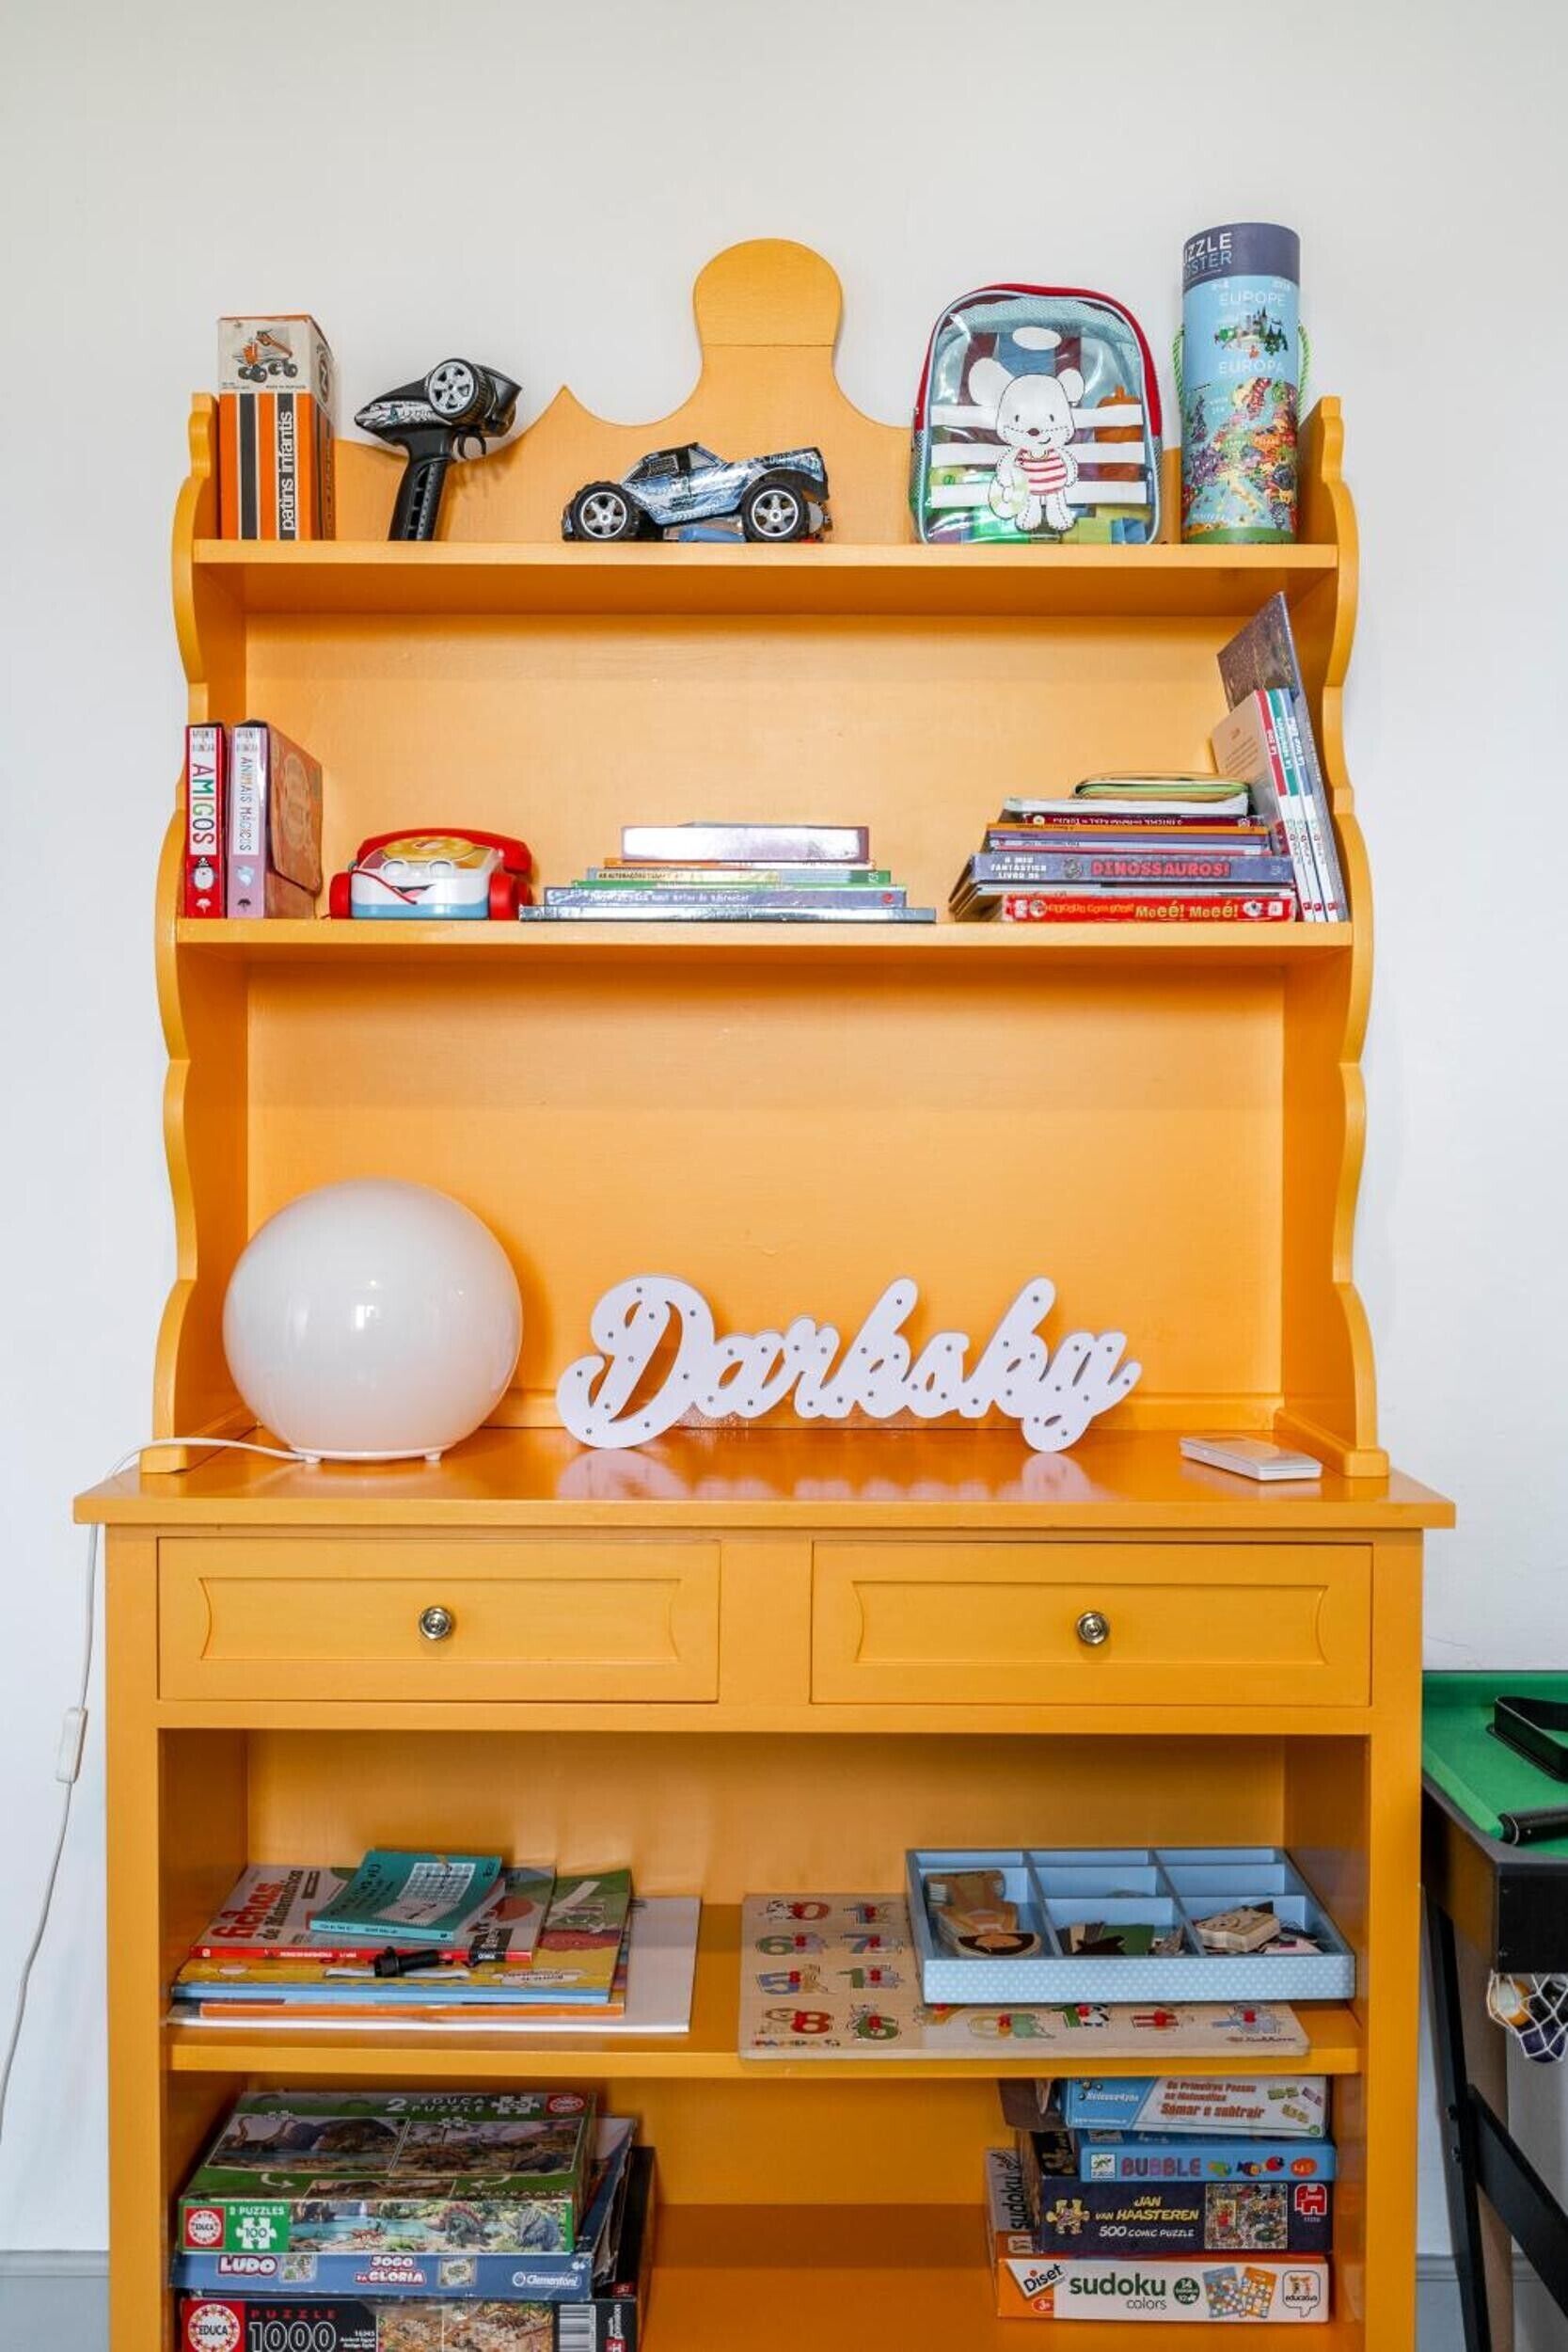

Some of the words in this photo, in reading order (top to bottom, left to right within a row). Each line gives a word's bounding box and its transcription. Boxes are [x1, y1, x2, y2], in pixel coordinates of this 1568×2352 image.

[1219, 291, 1287, 307] EUROPE
[1219, 358, 1287, 374] EUROPA
[278, 411, 294, 473] infantis
[279, 478, 295, 531] patins
[240, 755, 253, 804] ANIMAIS
[192, 763, 214, 845] AMIGOS
[1091, 859, 1231, 877] DINOSSAUROS!
[386, 2097, 408, 2112] 2
[1160, 2102, 1201, 2117] Somar
[1213, 2105, 1266, 2119] subtrair
[1120, 2157, 1202, 2178] BUBBLE
[999, 2175, 1030, 2230] sudoku
[1133, 2195, 1162, 2207] JAN
[239, 2205, 285, 2216] PUZZLES
[1116, 2208, 1200, 2221] HAASTEREN
[245, 2227, 268, 2239] 100
[1099, 2225, 1128, 2237] 500
[1128, 2229, 1159, 2237] COMIC
[1159, 2228, 1195, 2237] PUZZLE
[219, 2255, 277, 2275] LUDO
[371, 2255, 414, 2268] JOGO
[526, 2274, 578, 2287] Clementoni
[1022, 2263, 1064, 2293] Diset
[1069, 2272, 1167, 2297] sudoku
[1126, 2296, 1167, 2311] colors
[249, 2309, 339, 2320] PUZZLE
[198, 2324, 229, 2336] EDUCA
[247, 2320, 337, 2352] 1000
